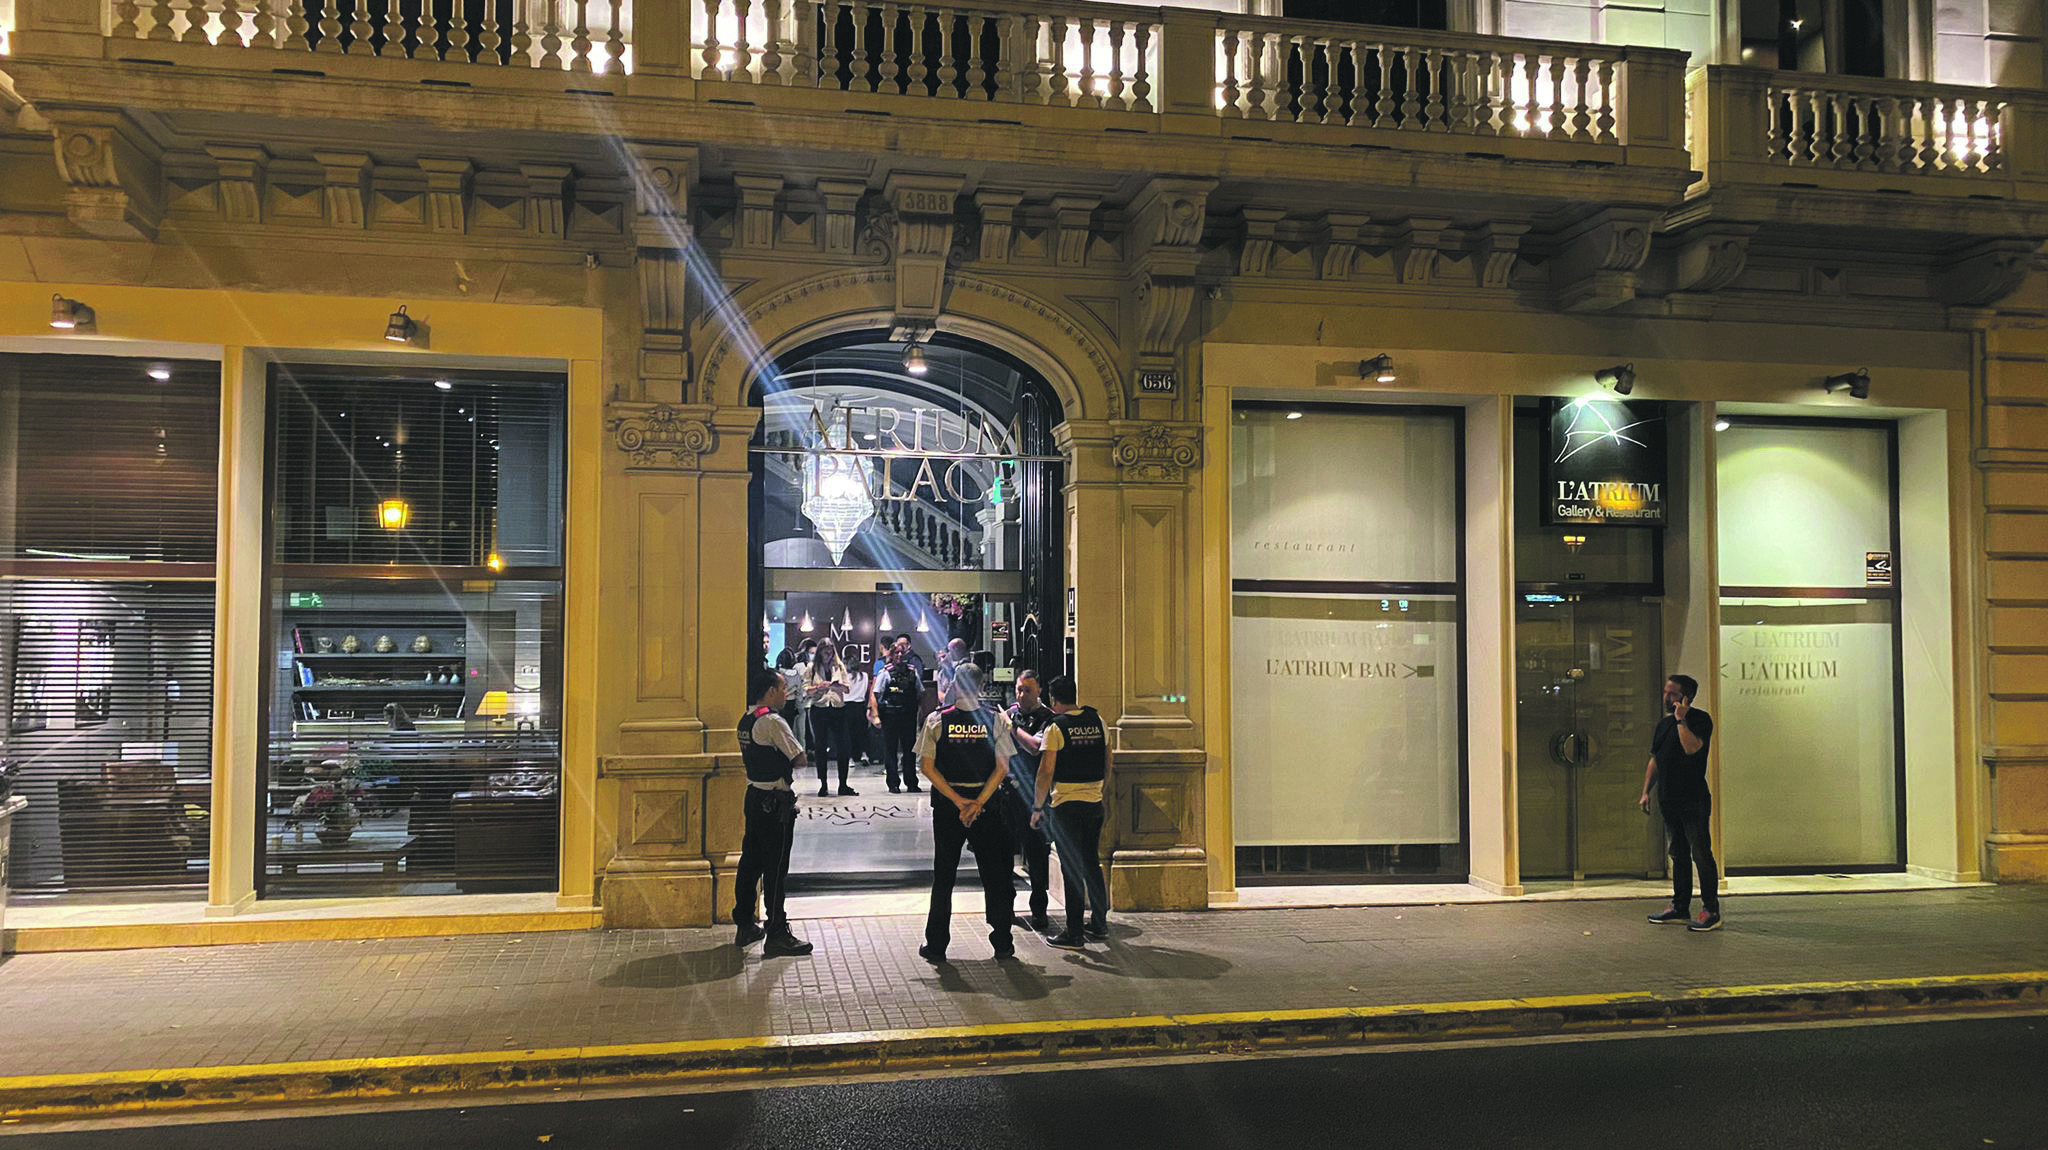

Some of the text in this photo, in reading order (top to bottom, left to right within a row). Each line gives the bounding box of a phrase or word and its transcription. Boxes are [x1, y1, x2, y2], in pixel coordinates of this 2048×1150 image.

[1143, 374, 1172, 390] 656
[801, 403, 1026, 457] ATRIUM
[1557, 480, 1661, 502] L'ATRIUM
[1557, 504, 1662, 520] Gallery & Restaurant
[1254, 540, 1356, 553] restaurant
[1266, 658, 1397, 679] L'ATRIUM BAR
[1740, 660, 1839, 680] L'ATRIUM
[1738, 685, 1806, 697] restaurant
[948, 724, 988, 734] POLICIA
[1068, 726, 1101, 736] POLICIA
